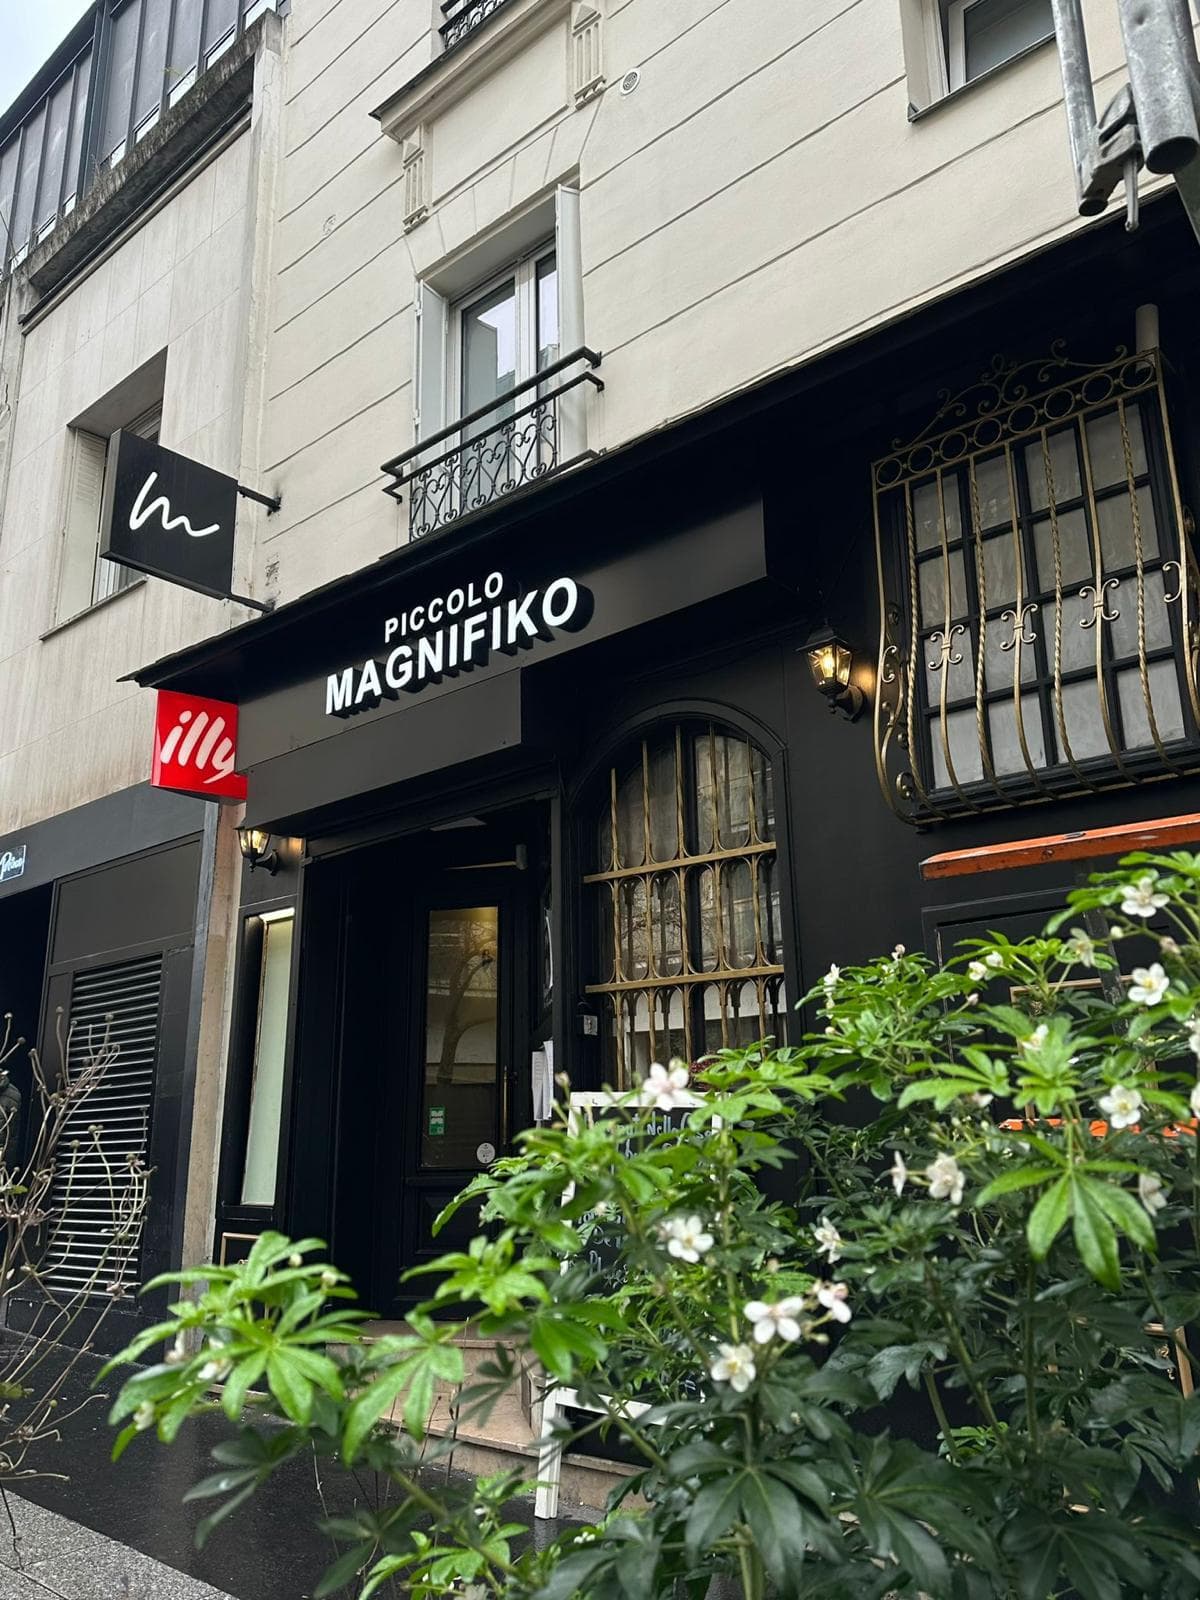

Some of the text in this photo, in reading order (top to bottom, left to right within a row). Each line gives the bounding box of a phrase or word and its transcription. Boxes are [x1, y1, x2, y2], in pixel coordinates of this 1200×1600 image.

[384, 571, 504, 643] PICCOLO
[325, 577, 578, 715] MAGNIFIKO
[160, 710, 236, 784] illy
